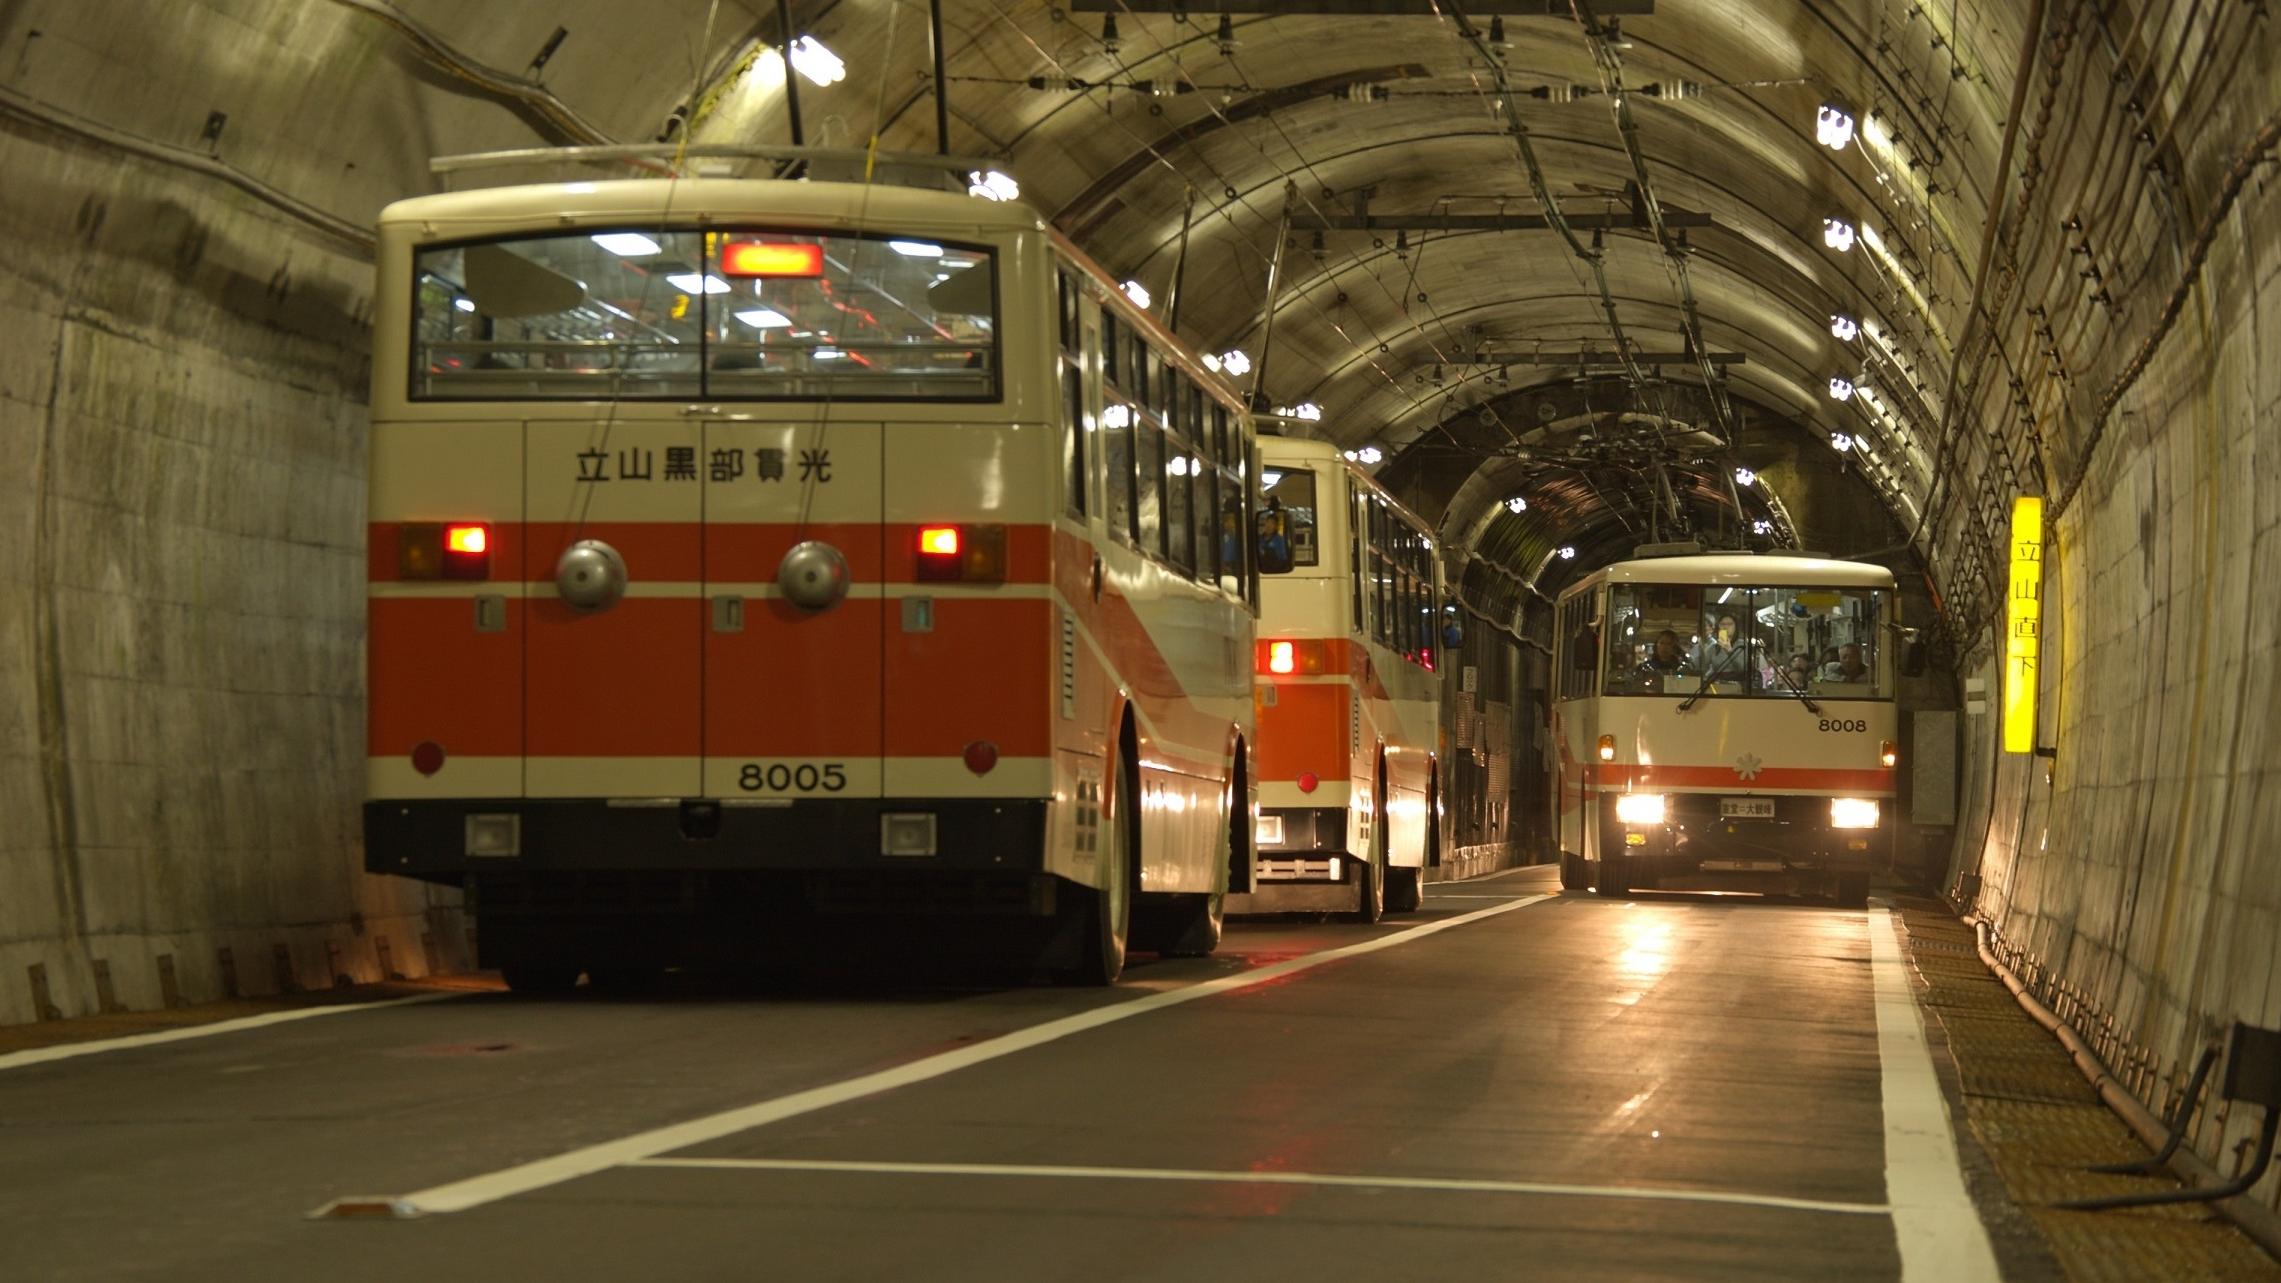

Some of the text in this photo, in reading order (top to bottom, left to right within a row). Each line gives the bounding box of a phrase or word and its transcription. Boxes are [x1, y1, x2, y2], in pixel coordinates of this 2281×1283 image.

[576, 447, 832, 483] 立山黒部貫光
[2012, 540, 2041, 677] 立山直下
[1818, 719, 1867, 732] 8008
[739, 763, 847, 792] 8005
